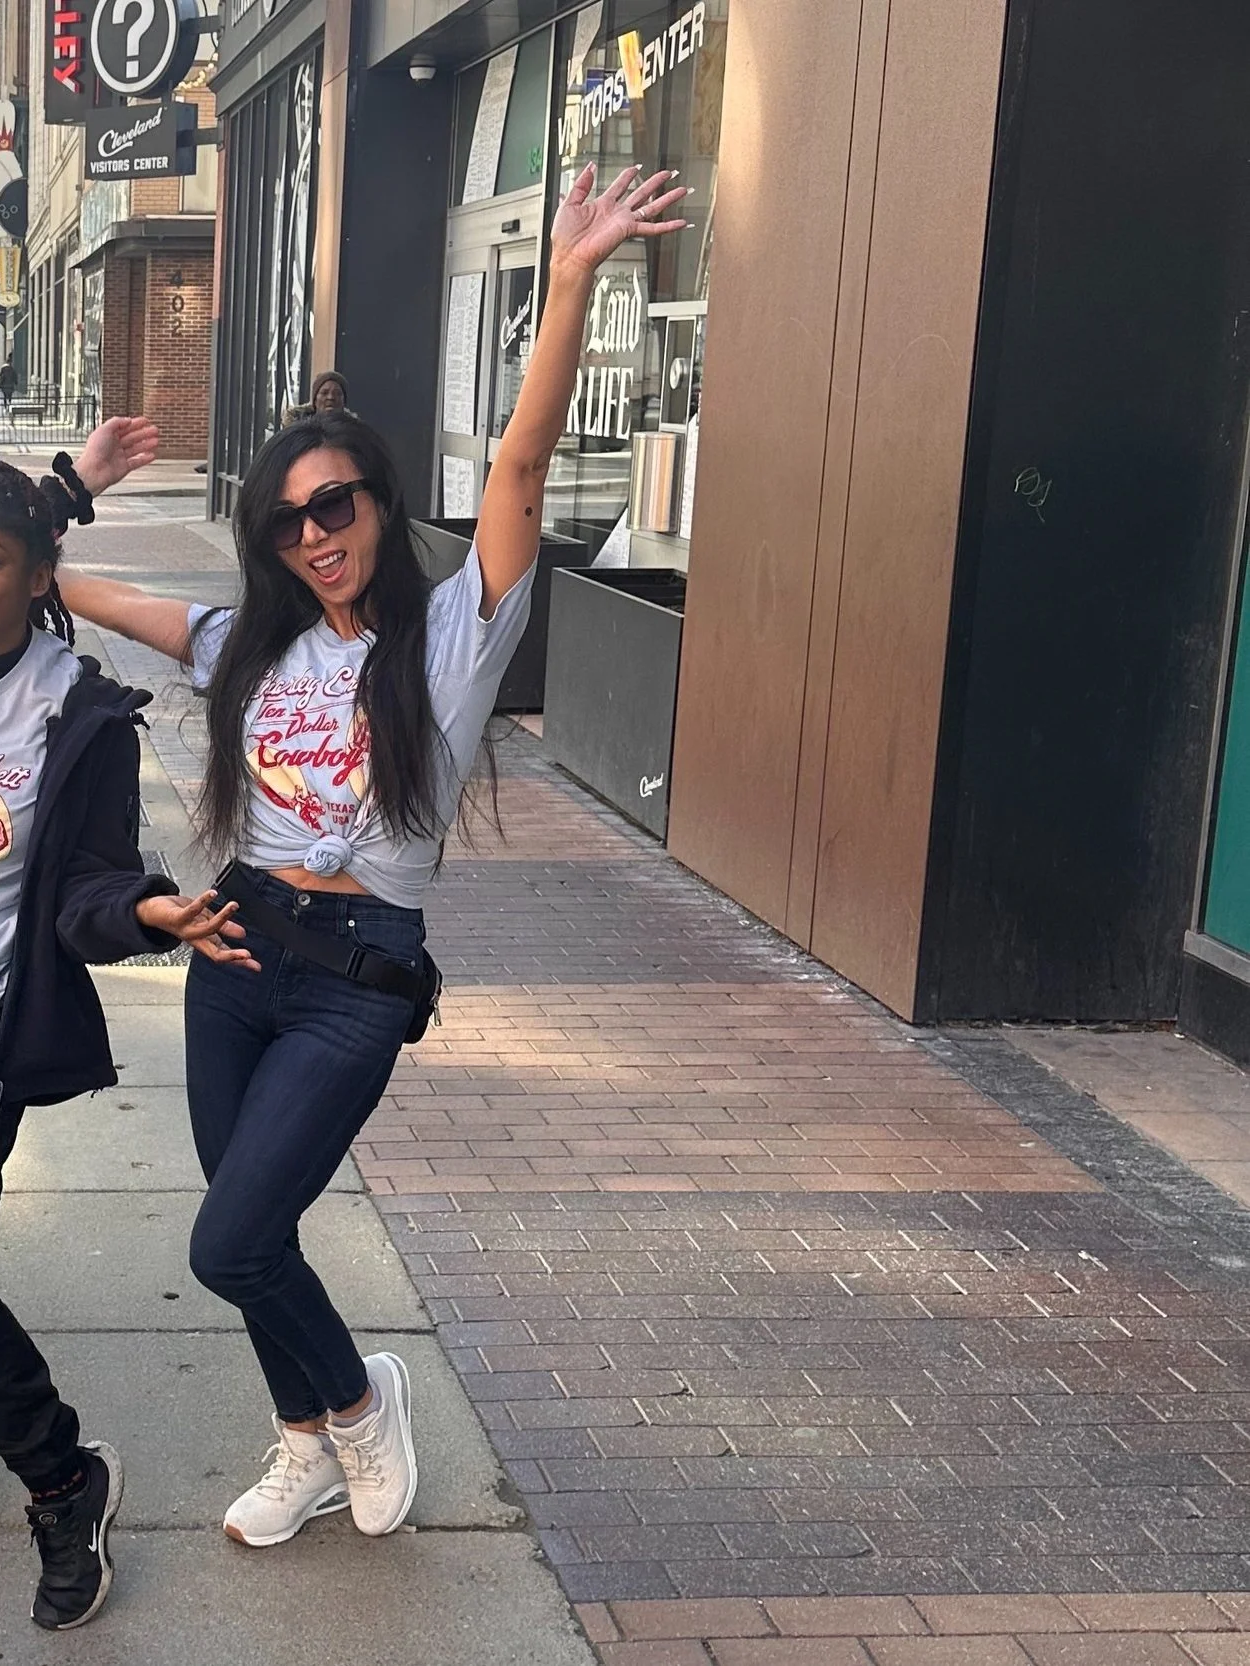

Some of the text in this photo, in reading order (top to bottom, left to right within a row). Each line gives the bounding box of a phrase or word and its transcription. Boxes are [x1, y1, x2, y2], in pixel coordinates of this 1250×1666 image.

[98, 106, 163, 158] Cleveland
[90, 156, 169, 174] VISITORS CENTER
[586, 265, 643, 354] Land
[584, 366, 634, 441] LIFE
[257, 703, 287, 720] Ten
[285, 711, 340, 740] Dollar
[254, 730, 366, 786] Cowboy
[332, 815, 350, 826] USA
